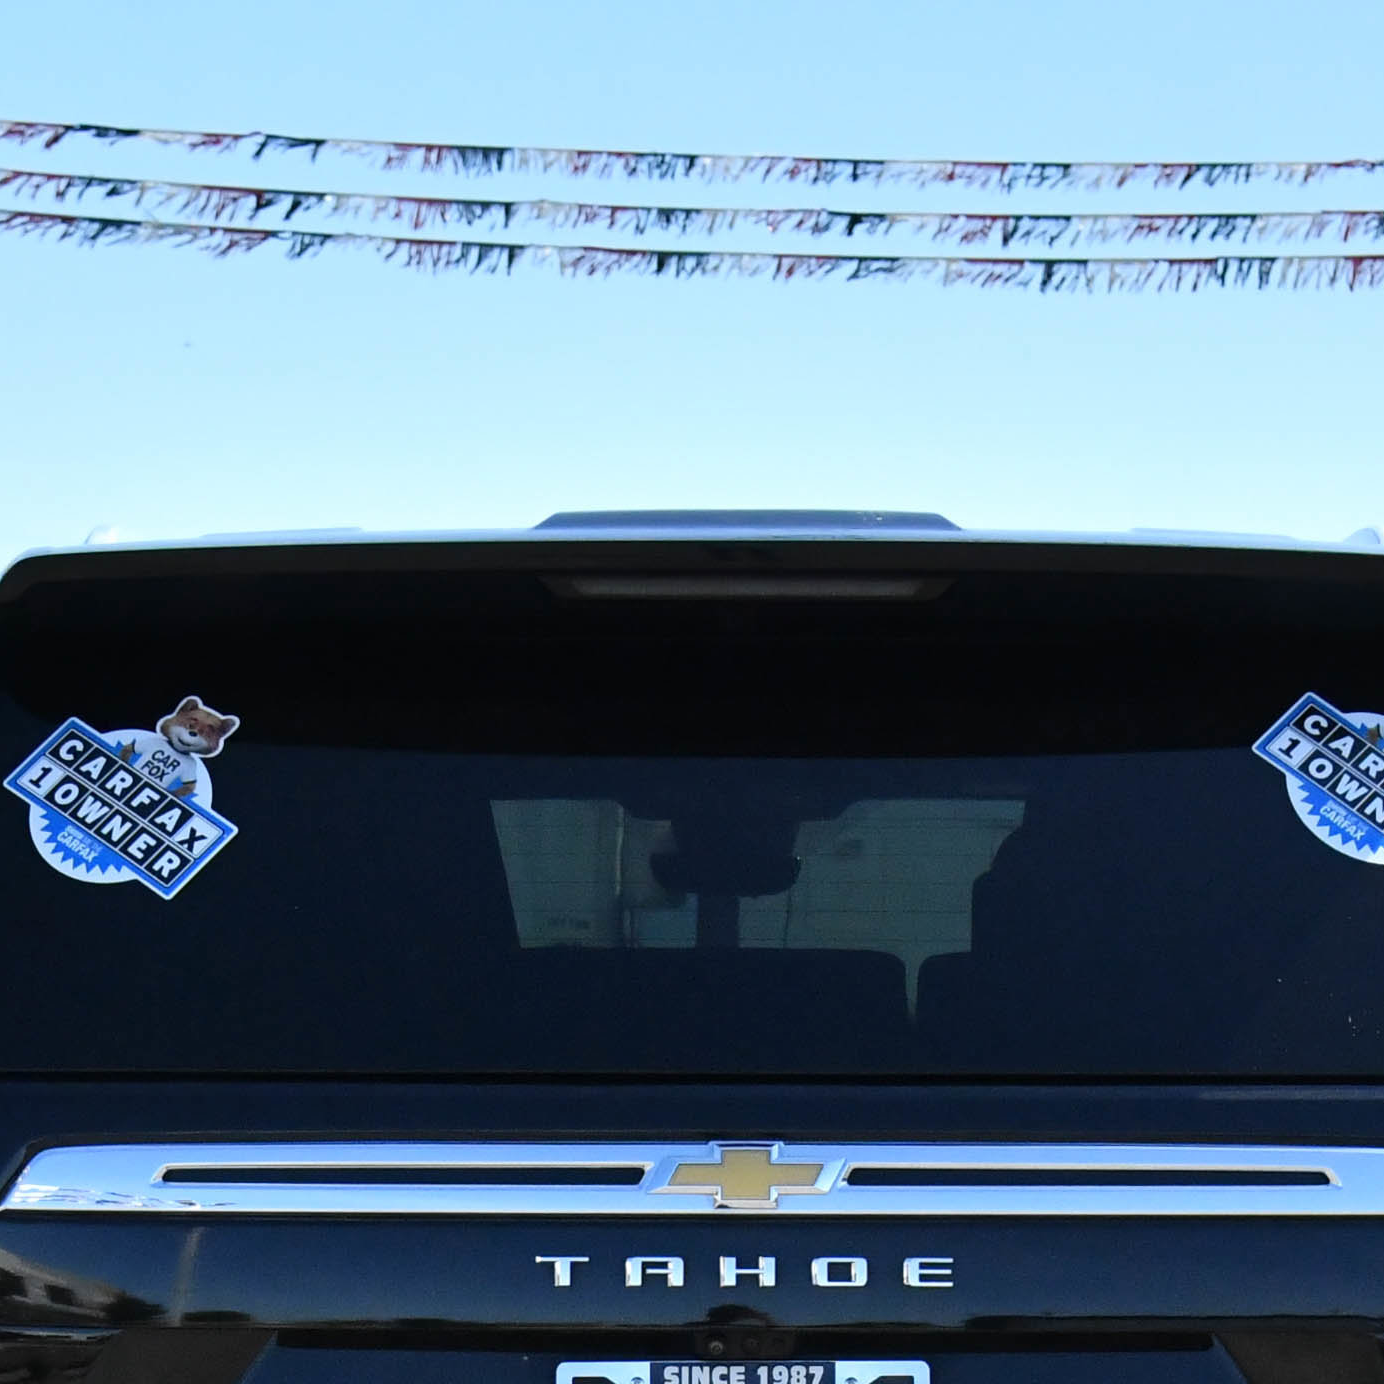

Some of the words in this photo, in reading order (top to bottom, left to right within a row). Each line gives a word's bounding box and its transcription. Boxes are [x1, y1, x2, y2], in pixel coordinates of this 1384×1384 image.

[151, 750, 181, 772] CAR
[1277, 736, 1302, 760] 1
[140, 759, 170, 782] FOX
[58, 739, 208, 854] CARFAX
[28, 765, 54, 789] 1
[54, 782, 182, 878] OWNER
[1320, 805, 1365, 841] CARFAX
[57, 831, 99, 863] CARFAX
[535, 1256, 955, 1288] TAHOE
